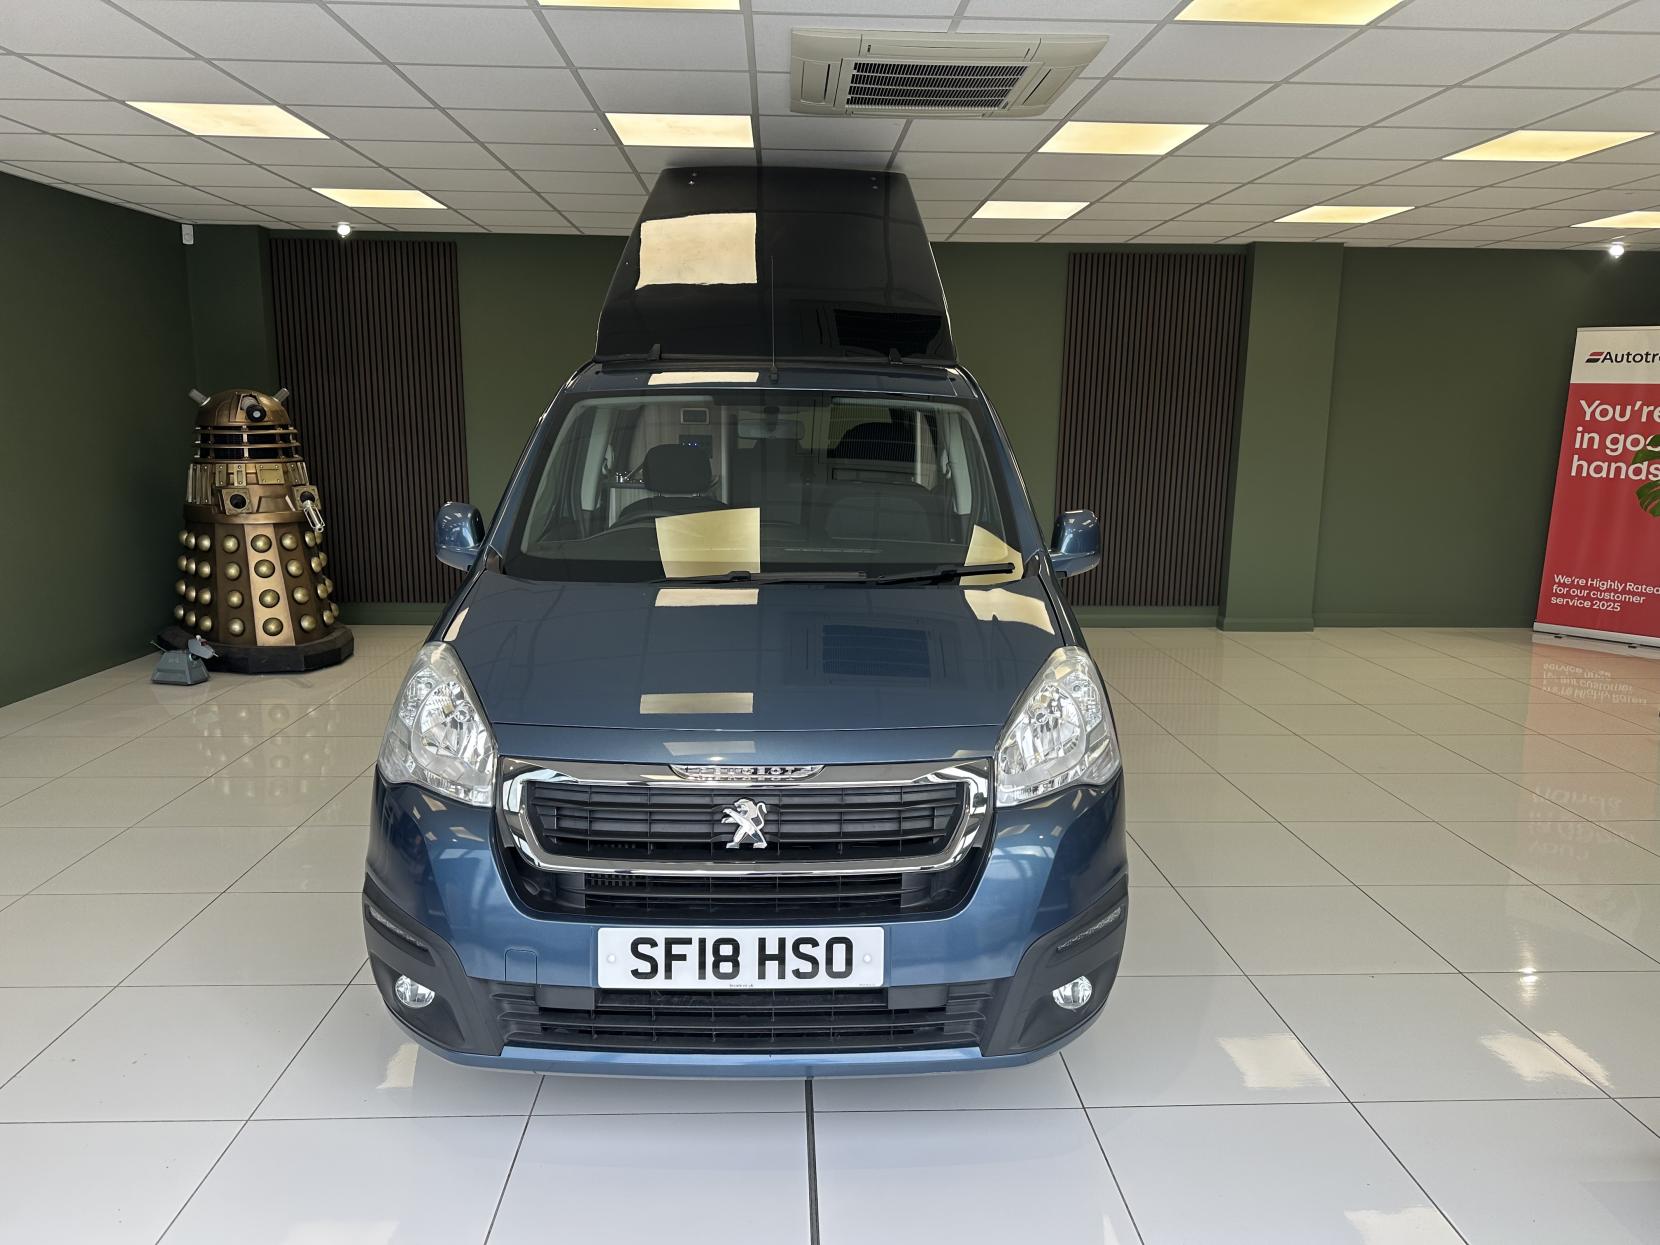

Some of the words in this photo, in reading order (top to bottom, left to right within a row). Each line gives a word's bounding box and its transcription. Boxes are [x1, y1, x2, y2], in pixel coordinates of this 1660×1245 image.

[1601, 351, 1660, 364] Autotr
[1574, 426, 1600, 449] in
[1554, 574, 1586, 585] We're
[1588, 578, 1625, 591] Highly
[1552, 585, 1569, 594] for
[1570, 588, 1589, 597] our
[1590, 590, 1646, 603] customer
[1551, 596, 1591, 608] service
[1592, 600, 1621, 612] 2025
[630, 936, 741, 980] SF18
[757, 936, 854, 980] HSO
